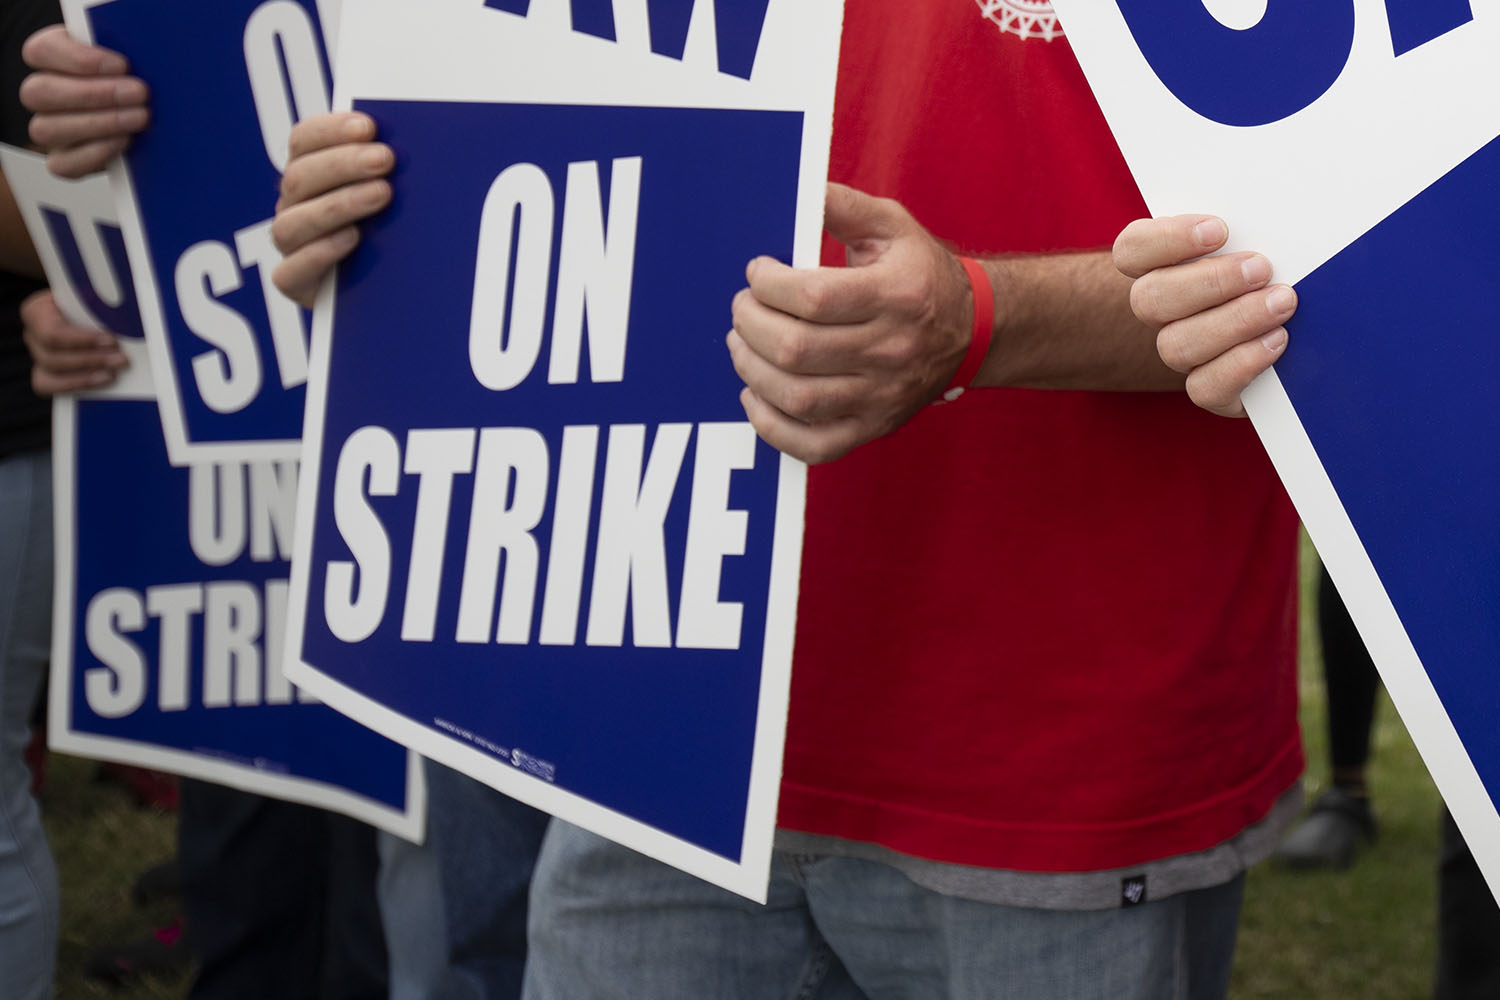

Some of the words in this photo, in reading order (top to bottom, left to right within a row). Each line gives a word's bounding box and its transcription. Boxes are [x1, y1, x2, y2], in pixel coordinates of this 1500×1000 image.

[468, 156, 642, 391] ON
[84, 578, 323, 718] STRI
[324, 422, 757, 650] STRIKE
